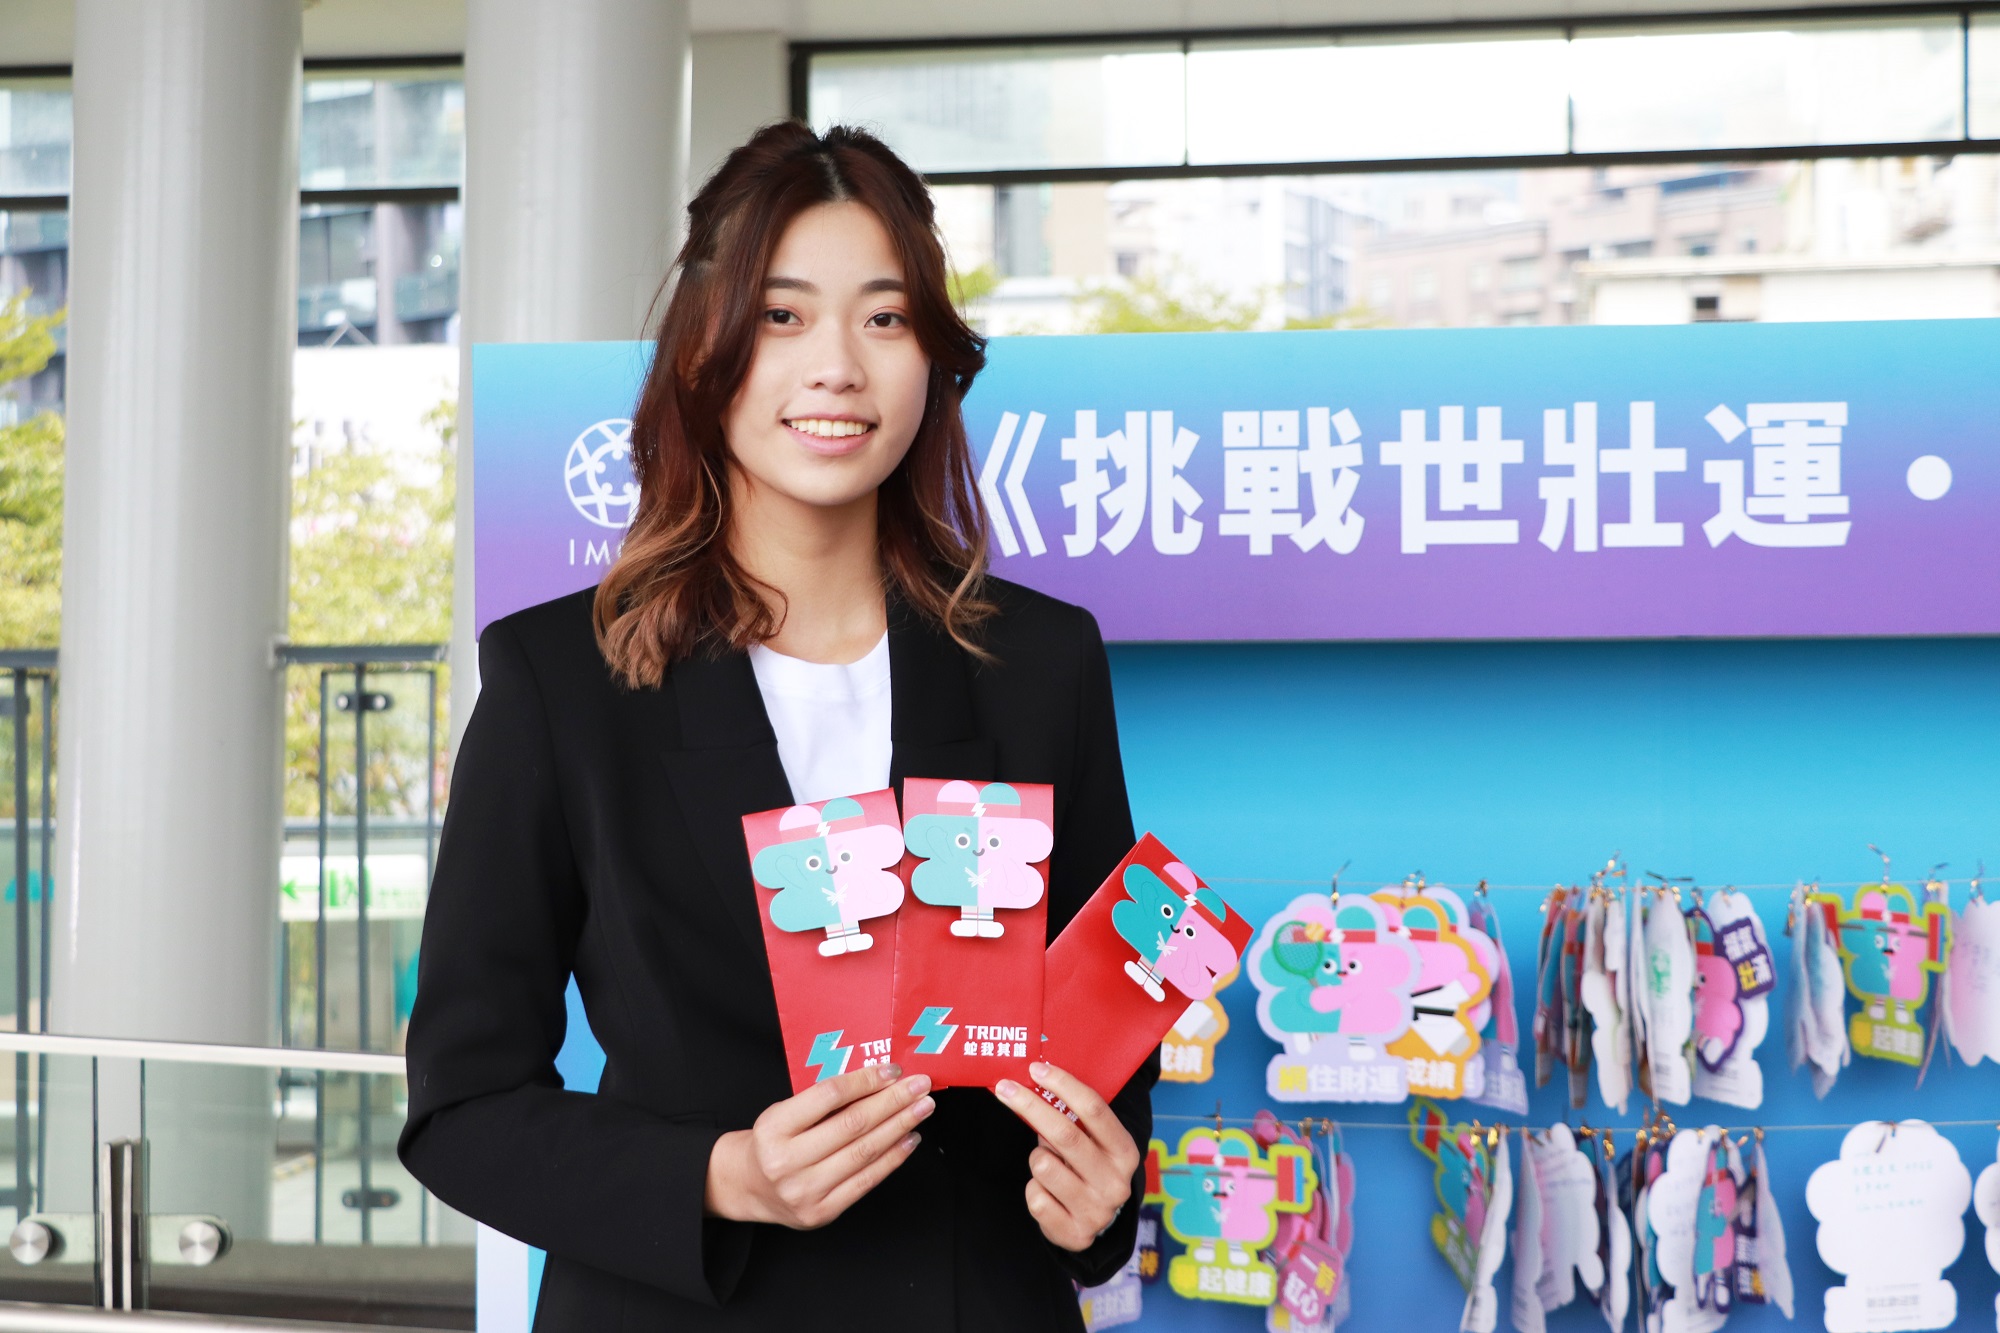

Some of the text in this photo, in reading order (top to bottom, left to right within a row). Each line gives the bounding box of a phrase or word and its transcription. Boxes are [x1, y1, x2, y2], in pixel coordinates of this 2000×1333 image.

[569, 538, 625, 566] IM
[964, 1024, 1028, 1042] TRONG
[963, 1041, 1028, 1058] 蛇我其誰
